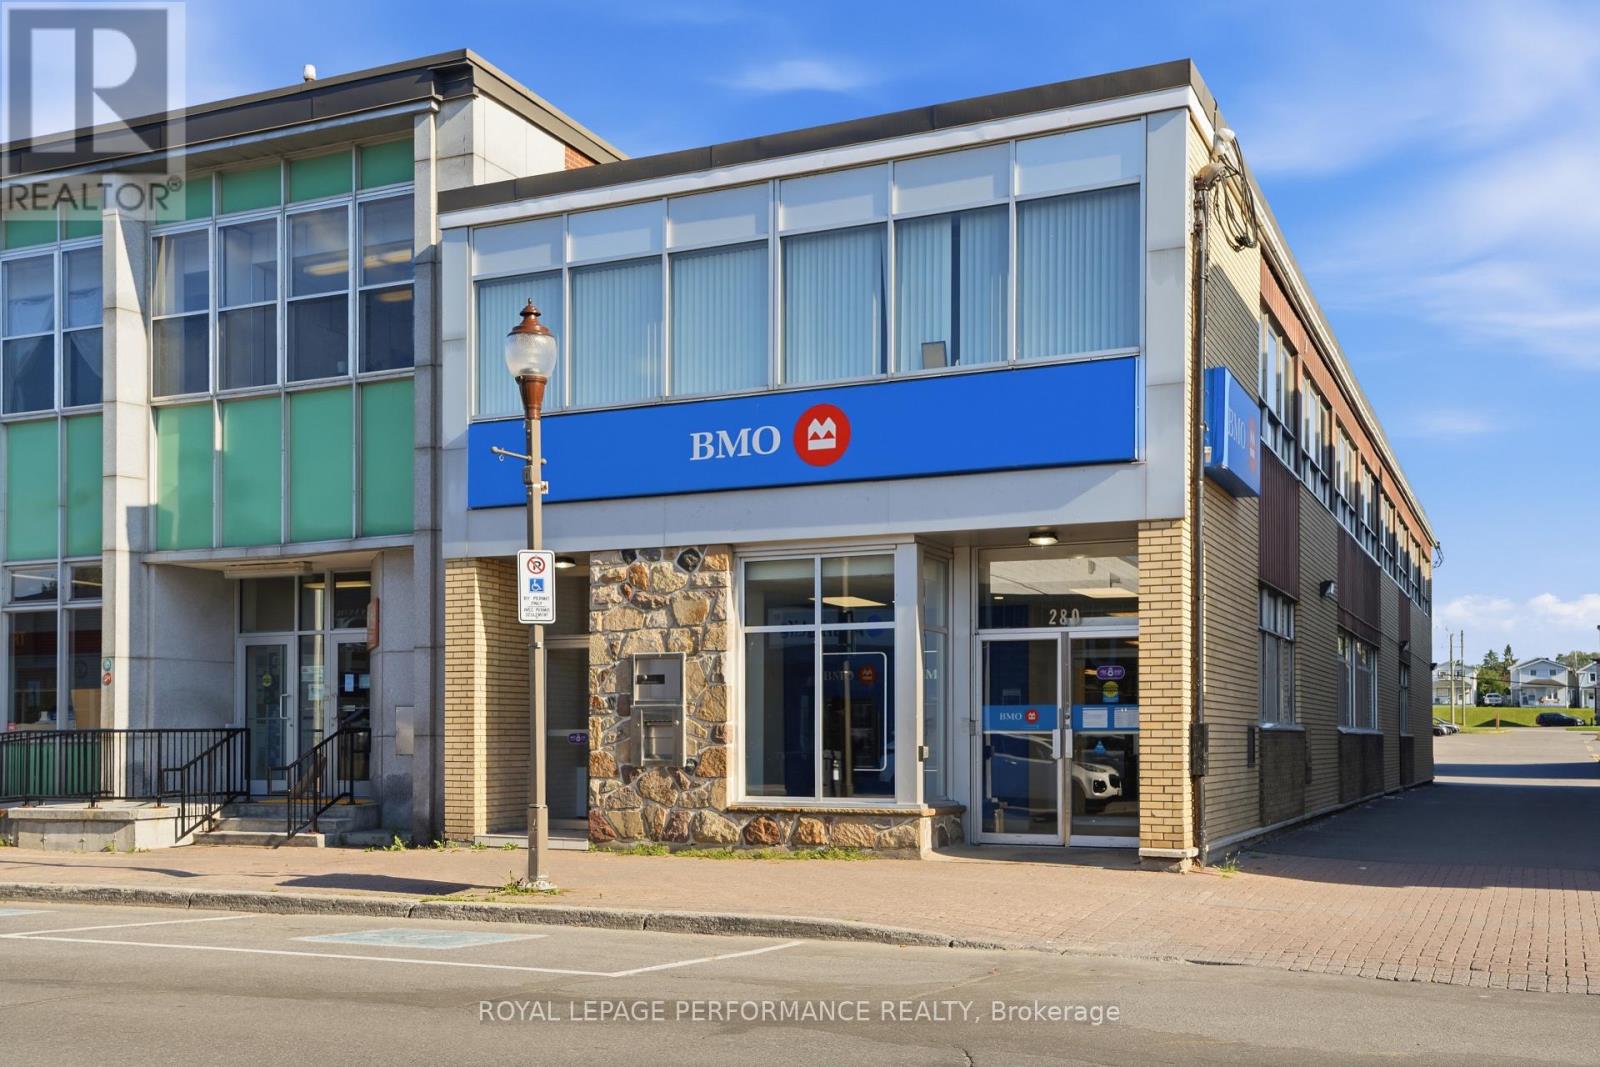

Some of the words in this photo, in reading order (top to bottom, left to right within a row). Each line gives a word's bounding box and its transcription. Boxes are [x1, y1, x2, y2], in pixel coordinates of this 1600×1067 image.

[1228, 408, 1246, 449] BMO
[689, 425, 781, 461] BMO
[1048, 608, 1080, 626] 280
[999, 710, 1023, 721] BMO
